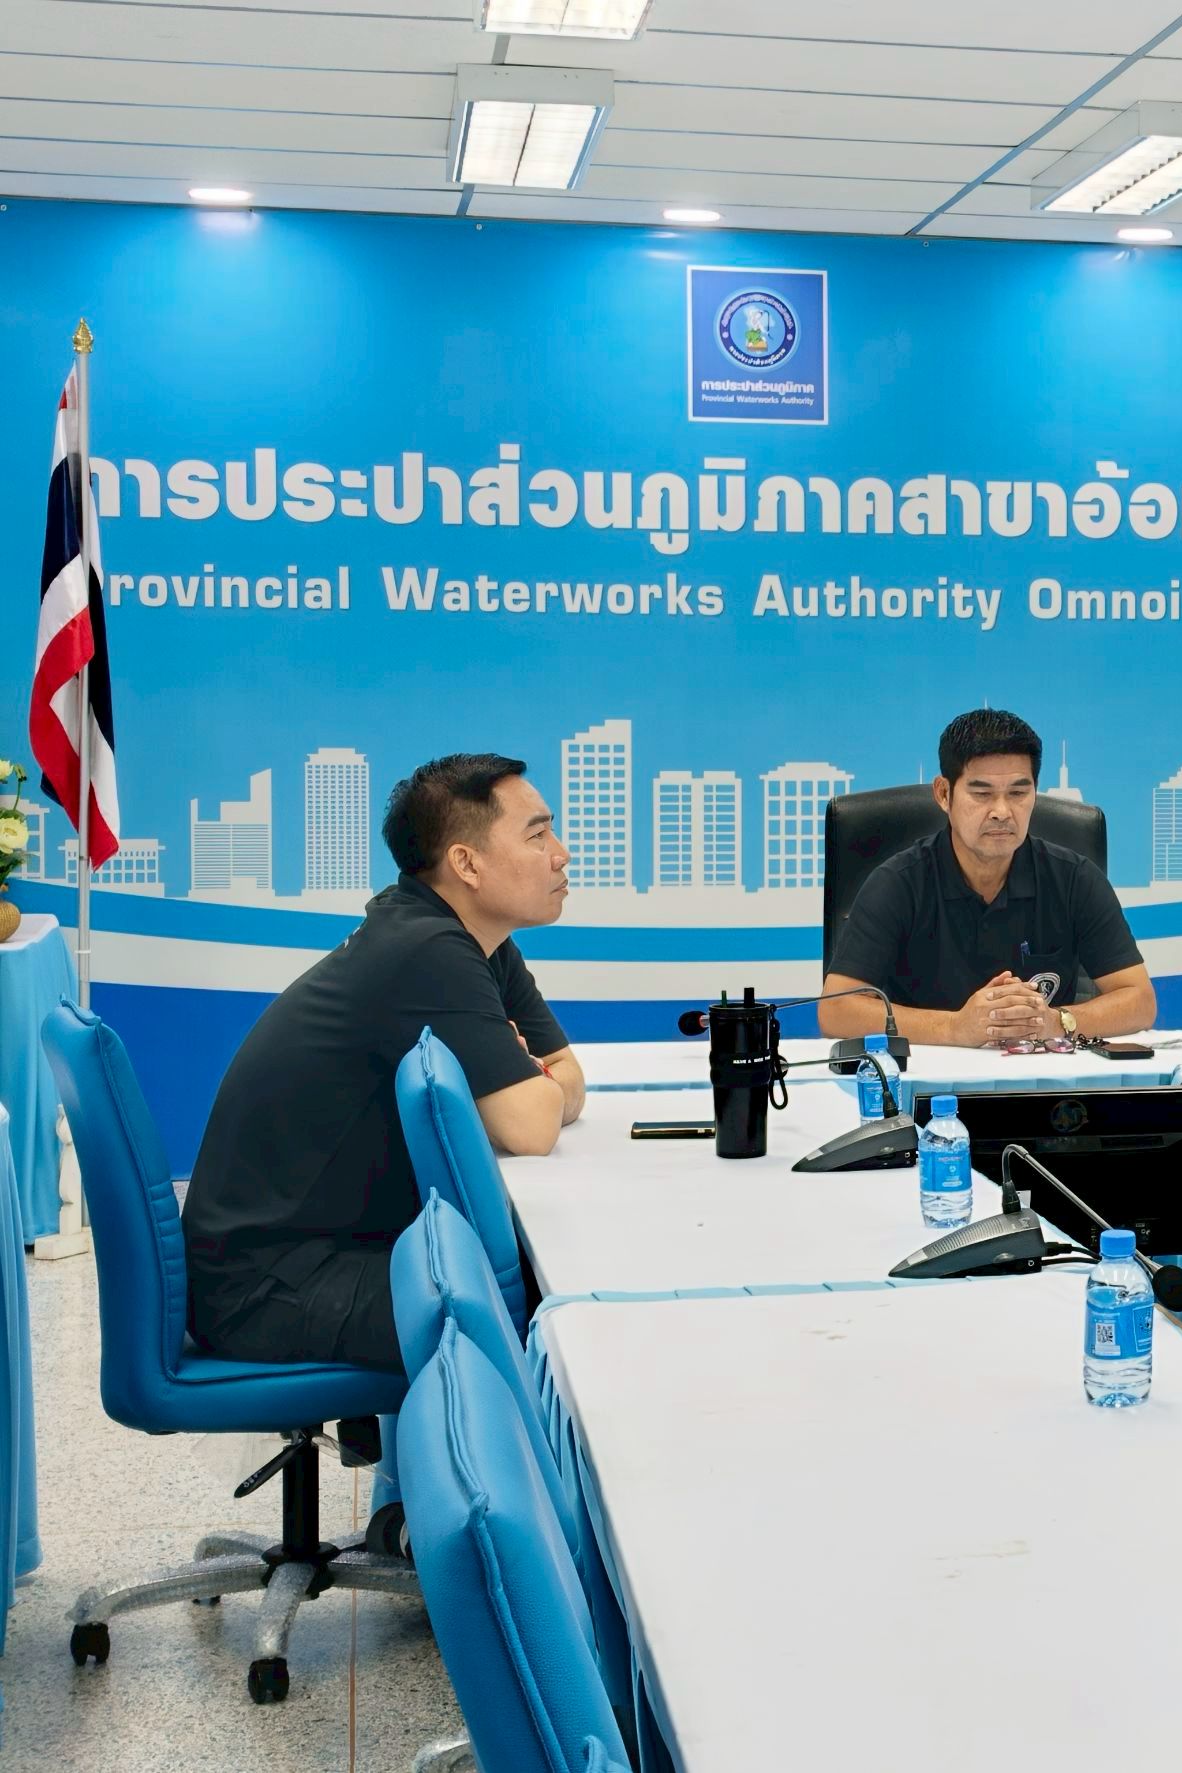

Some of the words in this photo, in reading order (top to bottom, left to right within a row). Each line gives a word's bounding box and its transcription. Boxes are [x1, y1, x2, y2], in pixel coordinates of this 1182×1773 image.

[701, 379, 815, 396] การประปาส่วนภูมิภาค
[701, 394, 735, 403] Provincial
[736, 395, 780, 405] Waterworks
[780, 396, 815, 407] Authority
[102, 564, 350, 610] rovincial
[381, 566, 724, 616] Waterworks
[752, 574, 1002, 631] Authority
[1028, 577, 1180, 620] Omnoi
